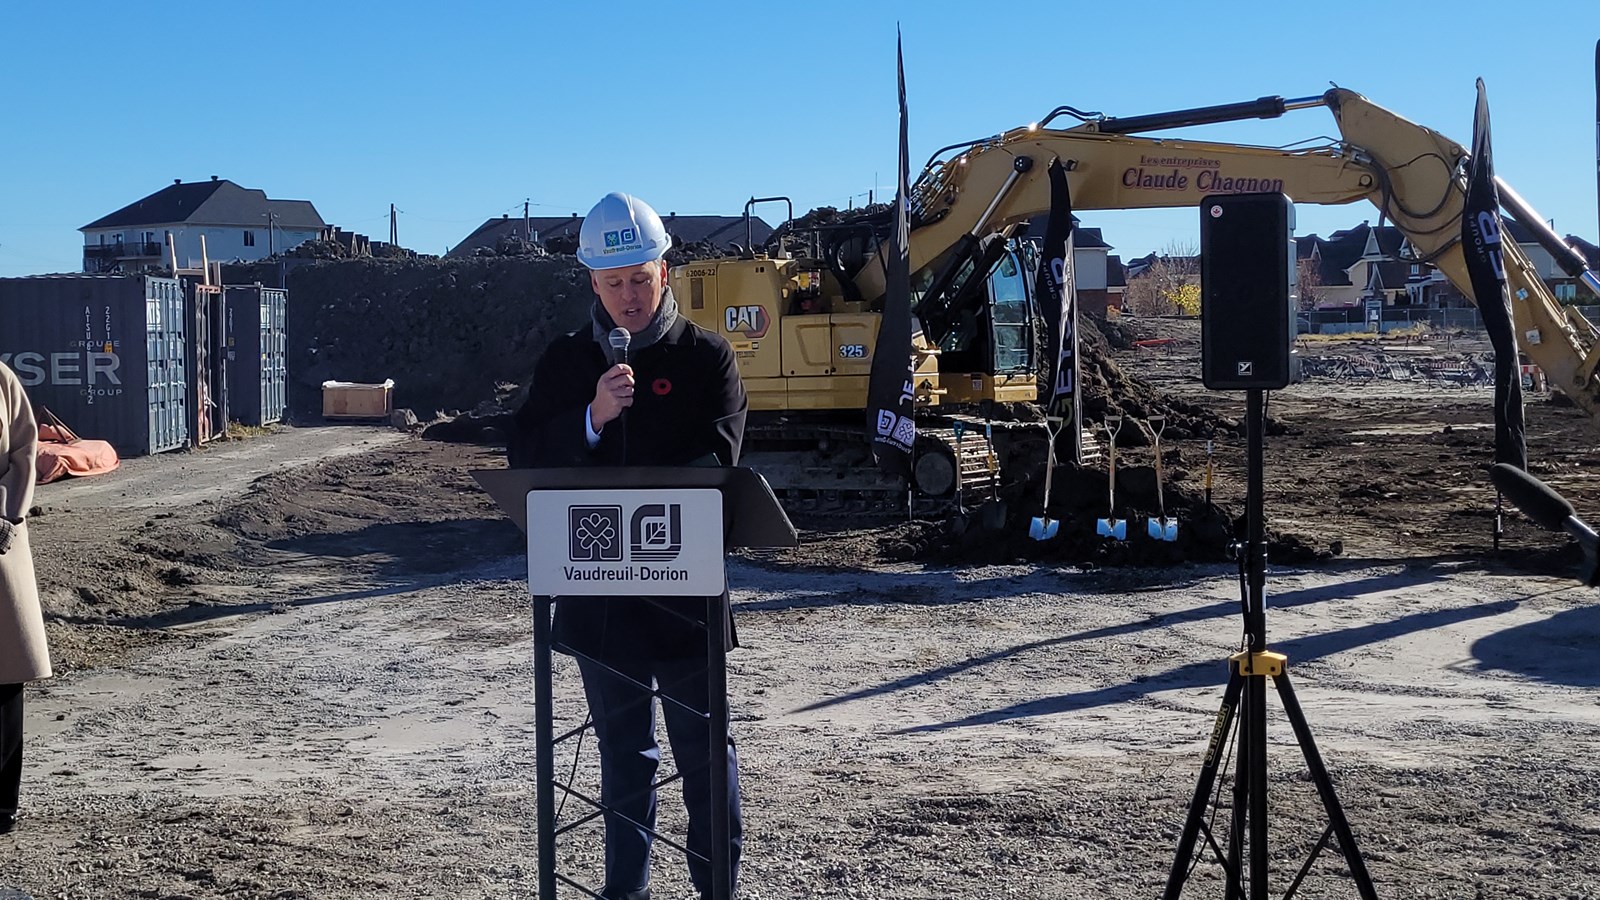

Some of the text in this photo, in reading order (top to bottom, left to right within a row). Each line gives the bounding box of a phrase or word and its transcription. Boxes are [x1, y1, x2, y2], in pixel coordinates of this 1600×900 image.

[1140, 155, 1220, 168] Les entreprises
[1122, 167, 1284, 193] Claude Chagnon
[686, 268, 716, 277] 62006-22
[725, 306, 759, 332] CAT
[839, 345, 864, 359] 325
[0, 352, 122, 386] SER
[564, 567, 689, 581] Vaudreuil-Dorion
